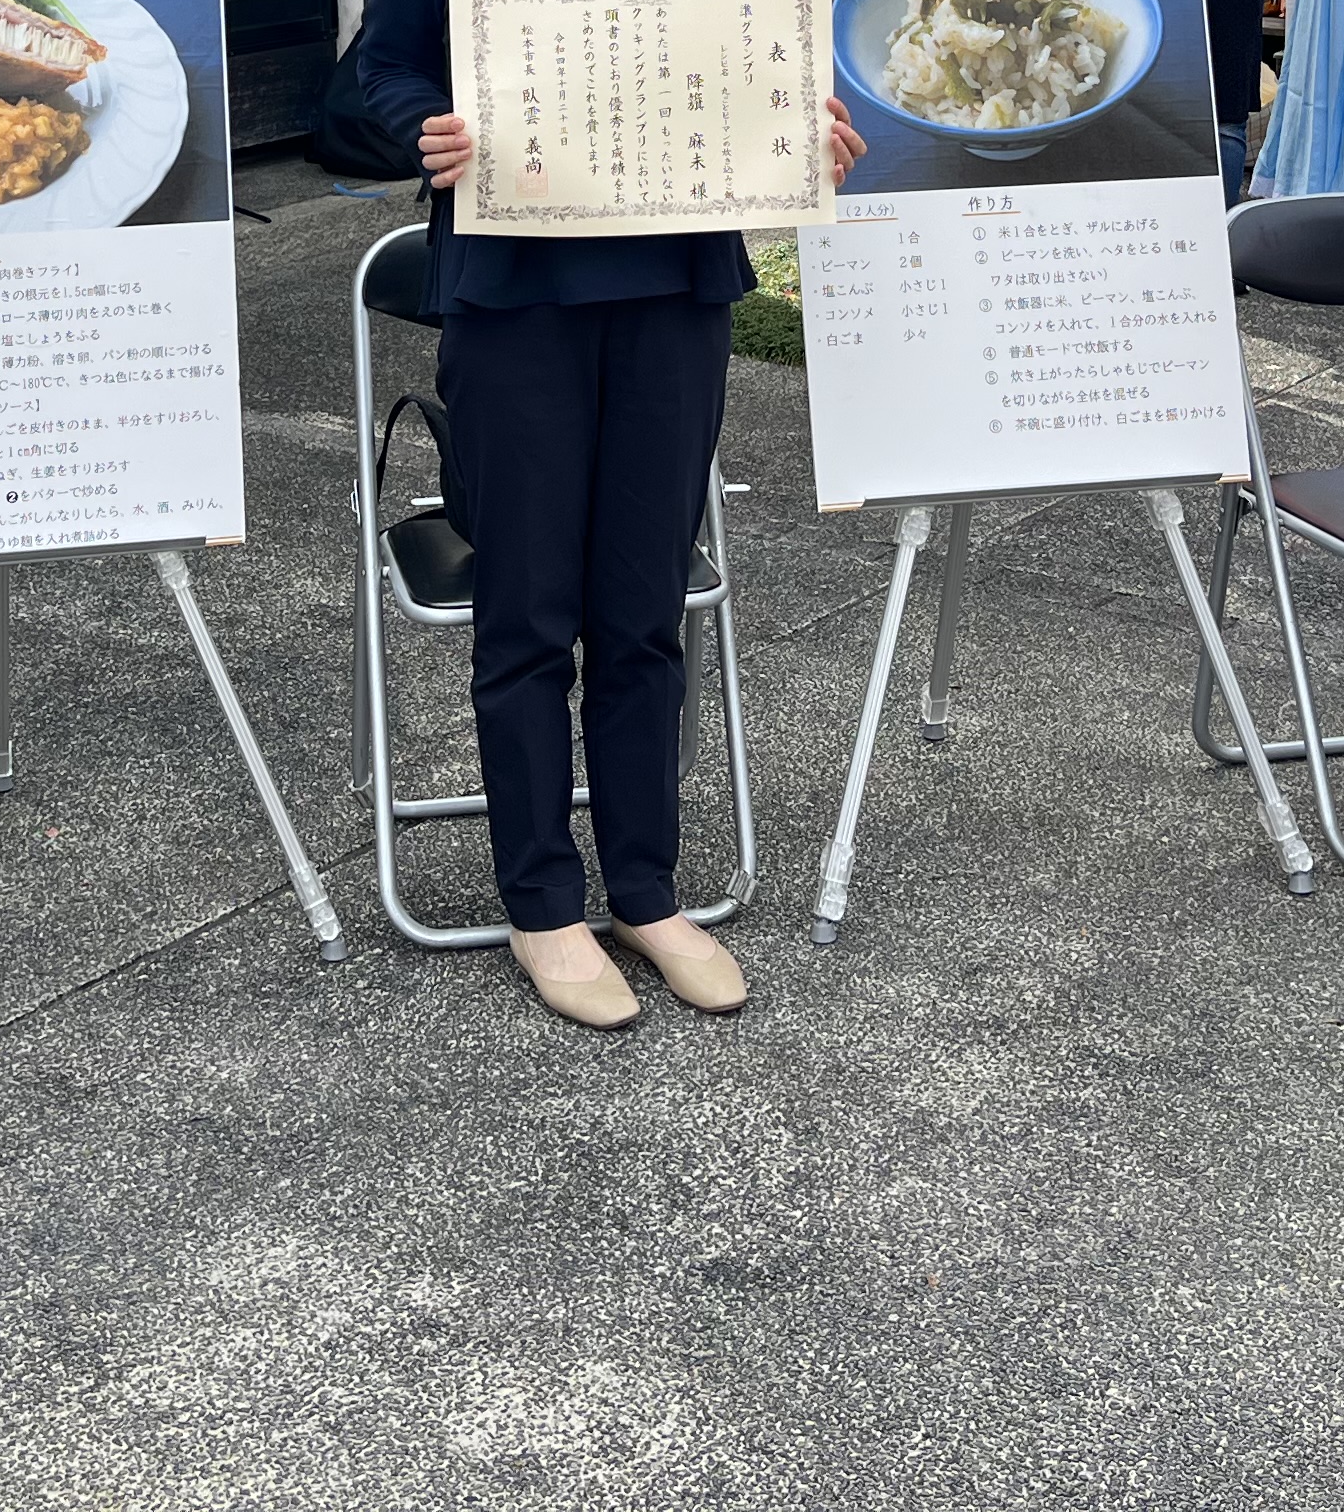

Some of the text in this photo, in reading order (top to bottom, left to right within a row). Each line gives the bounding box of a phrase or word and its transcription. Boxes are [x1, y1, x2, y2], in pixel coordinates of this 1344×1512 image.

[521, 24, 536, 76] 松本市長
[582, 10, 600, 177] さめたのでこれを賞します
[632, 7, 649, 203] クッキンググランプリにおいて
[768, 41, 792, 158] 表彰状
[967, 194, 1013, 212] 作り方
